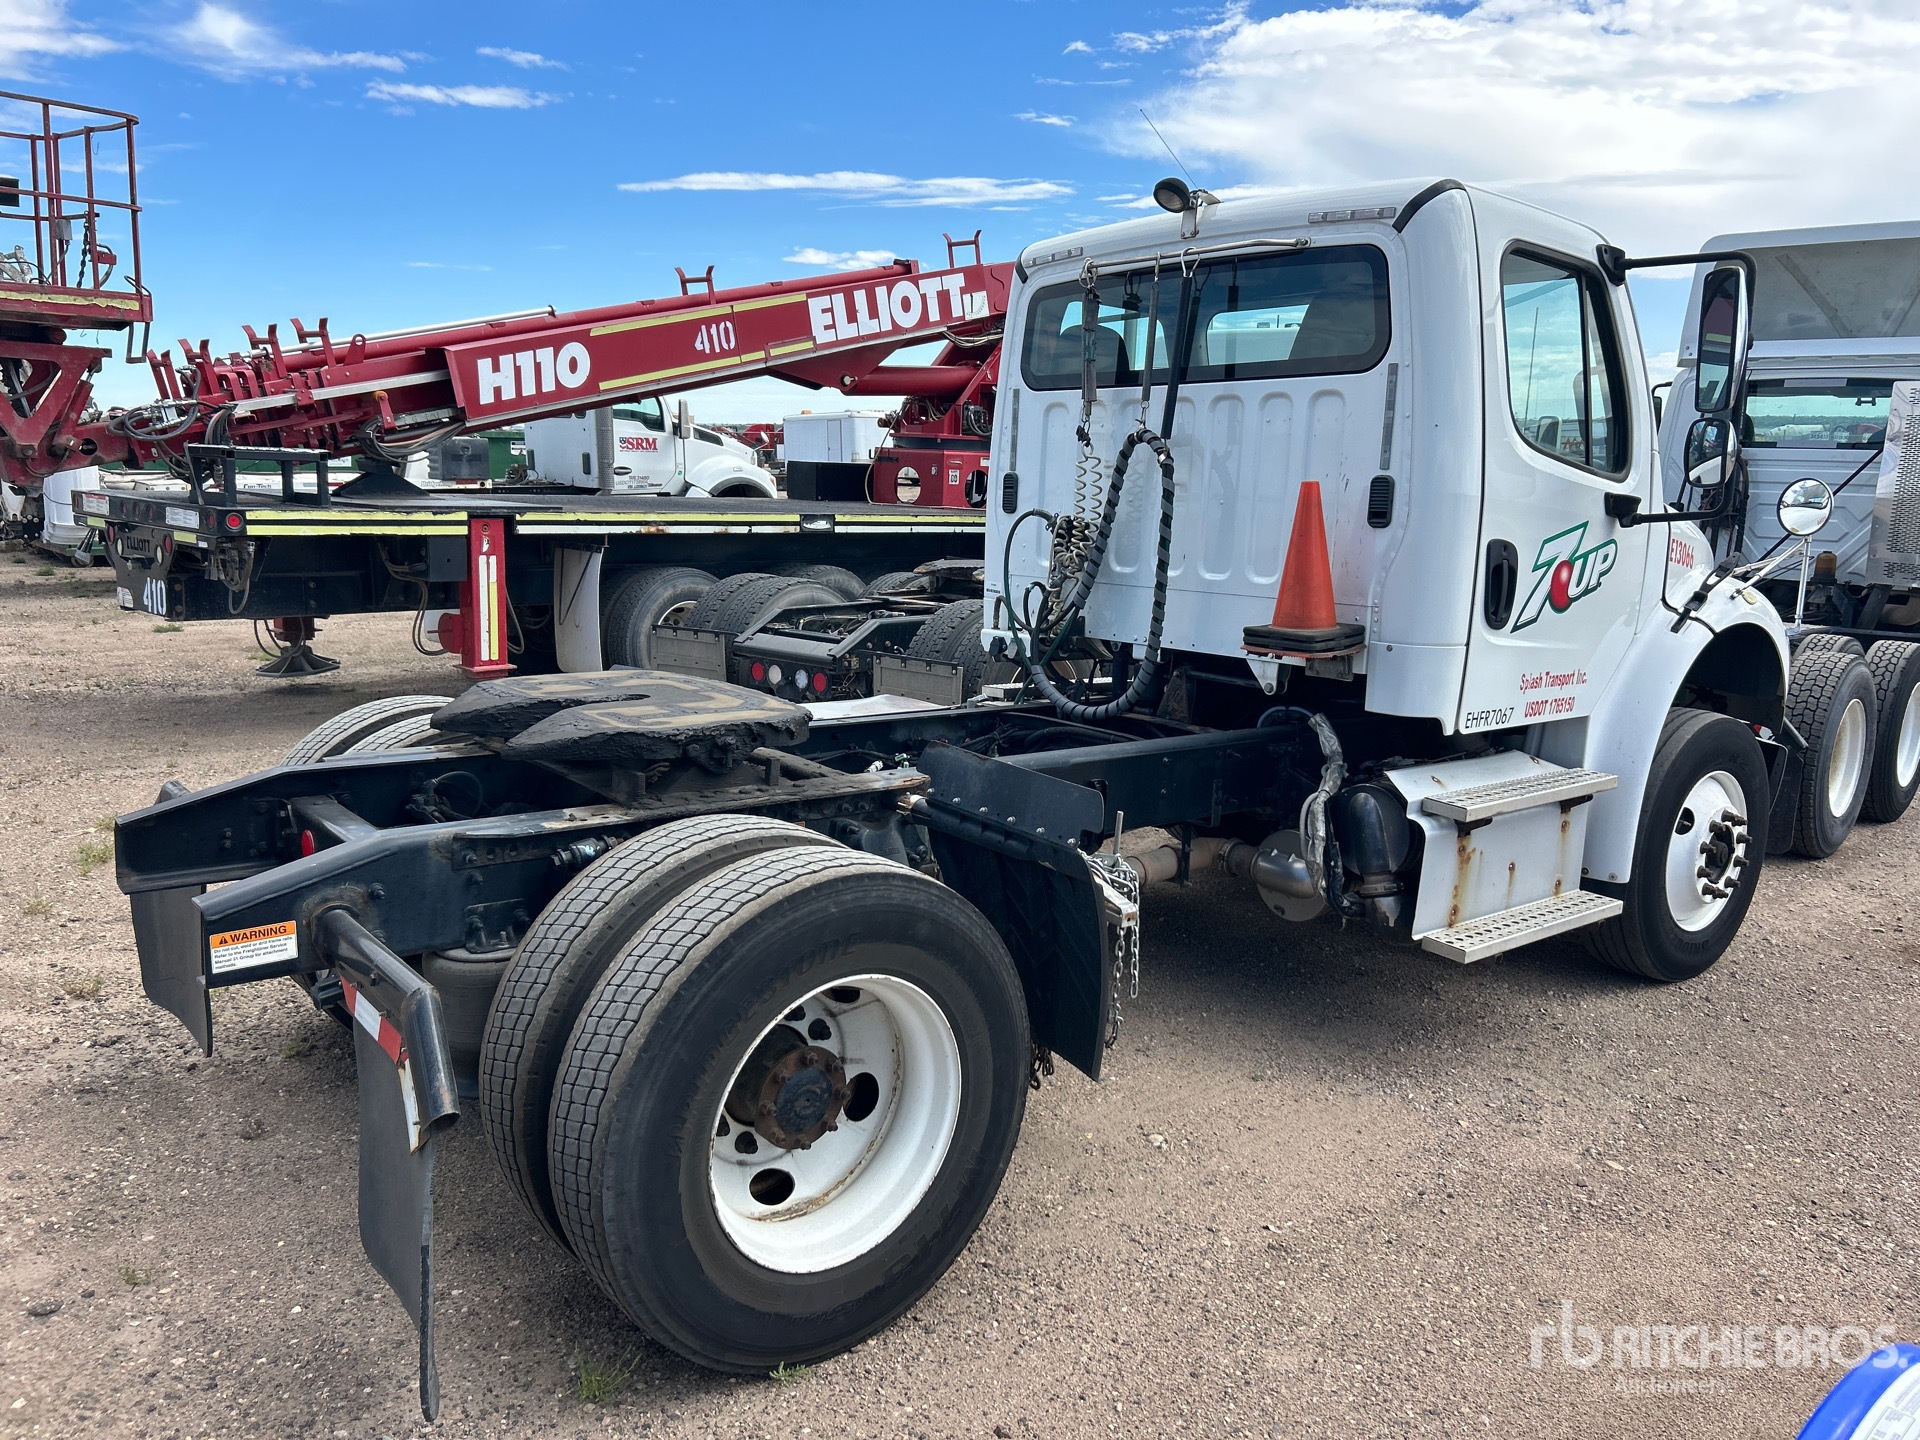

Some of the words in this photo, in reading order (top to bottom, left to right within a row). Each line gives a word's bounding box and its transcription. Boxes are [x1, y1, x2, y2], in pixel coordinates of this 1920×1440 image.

[807, 273, 965, 344] ELLIOTT
[694, 320, 736, 354] 410
[477, 341, 591, 404] H110
[626, 437, 658, 450] SRM
[126, 536, 151, 553] ELLIOTT
[1669, 538, 1695, 569] E13066
[143, 577, 167, 615] 410
[1519, 673, 1543, 694] Splash
[1544, 671, 1576, 690] Transport
[1576, 668, 1588, 685] Inc.
[1465, 707, 1514, 729] EHFR7067
[1524, 699, 1548, 718] USDOT
[1548, 696, 1576, 715] 1765150
[230, 925, 287, 942] WARNING
